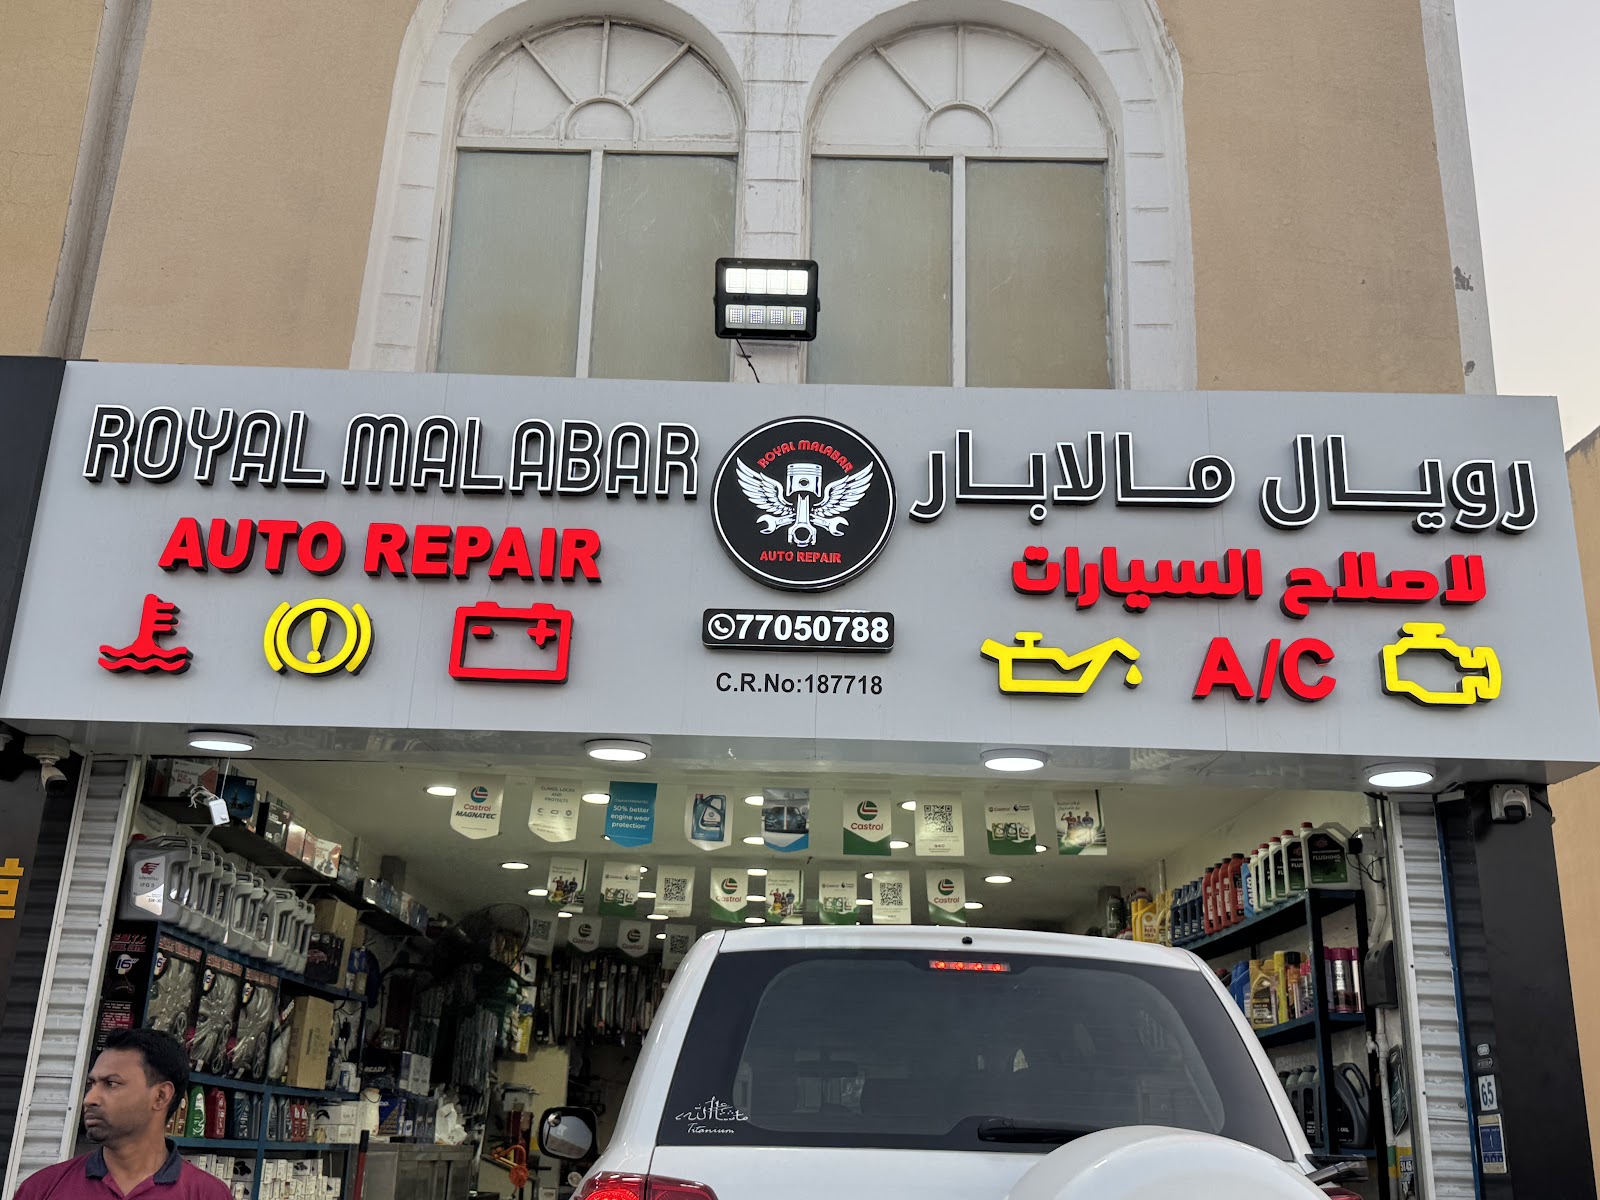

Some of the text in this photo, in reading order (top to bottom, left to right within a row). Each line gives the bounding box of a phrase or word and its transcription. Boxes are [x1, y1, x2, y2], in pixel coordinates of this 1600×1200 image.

[82, 404, 699, 499] ROYAL MALABAR
[757, 439, 854, 473] ROYAL MALABAR
[909, 429, 1539, 532] رويال مالابار
[158, 517, 603, 584] AUTO REPAIR
[760, 550, 842, 564] AUTO REPAIR
[1011, 546, 1487, 618] لاصلاح السيارات
[736, 614, 890, 643] 77050788
[1192, 636, 1337, 702] A/C
[463, 803, 492, 812] Castrol
[613, 804, 650, 814] 50% better
[455, 810, 498, 820] MAGNATEC
[610, 813, 650, 822] engine wear
[850, 822, 884, 831] Castrol
[716, 895, 742, 903] Castrol
[933, 896, 960, 904] Castrol
[1480, 1081, 1494, 1106] 65
[687, 1122, 735, 1134] Titanium
